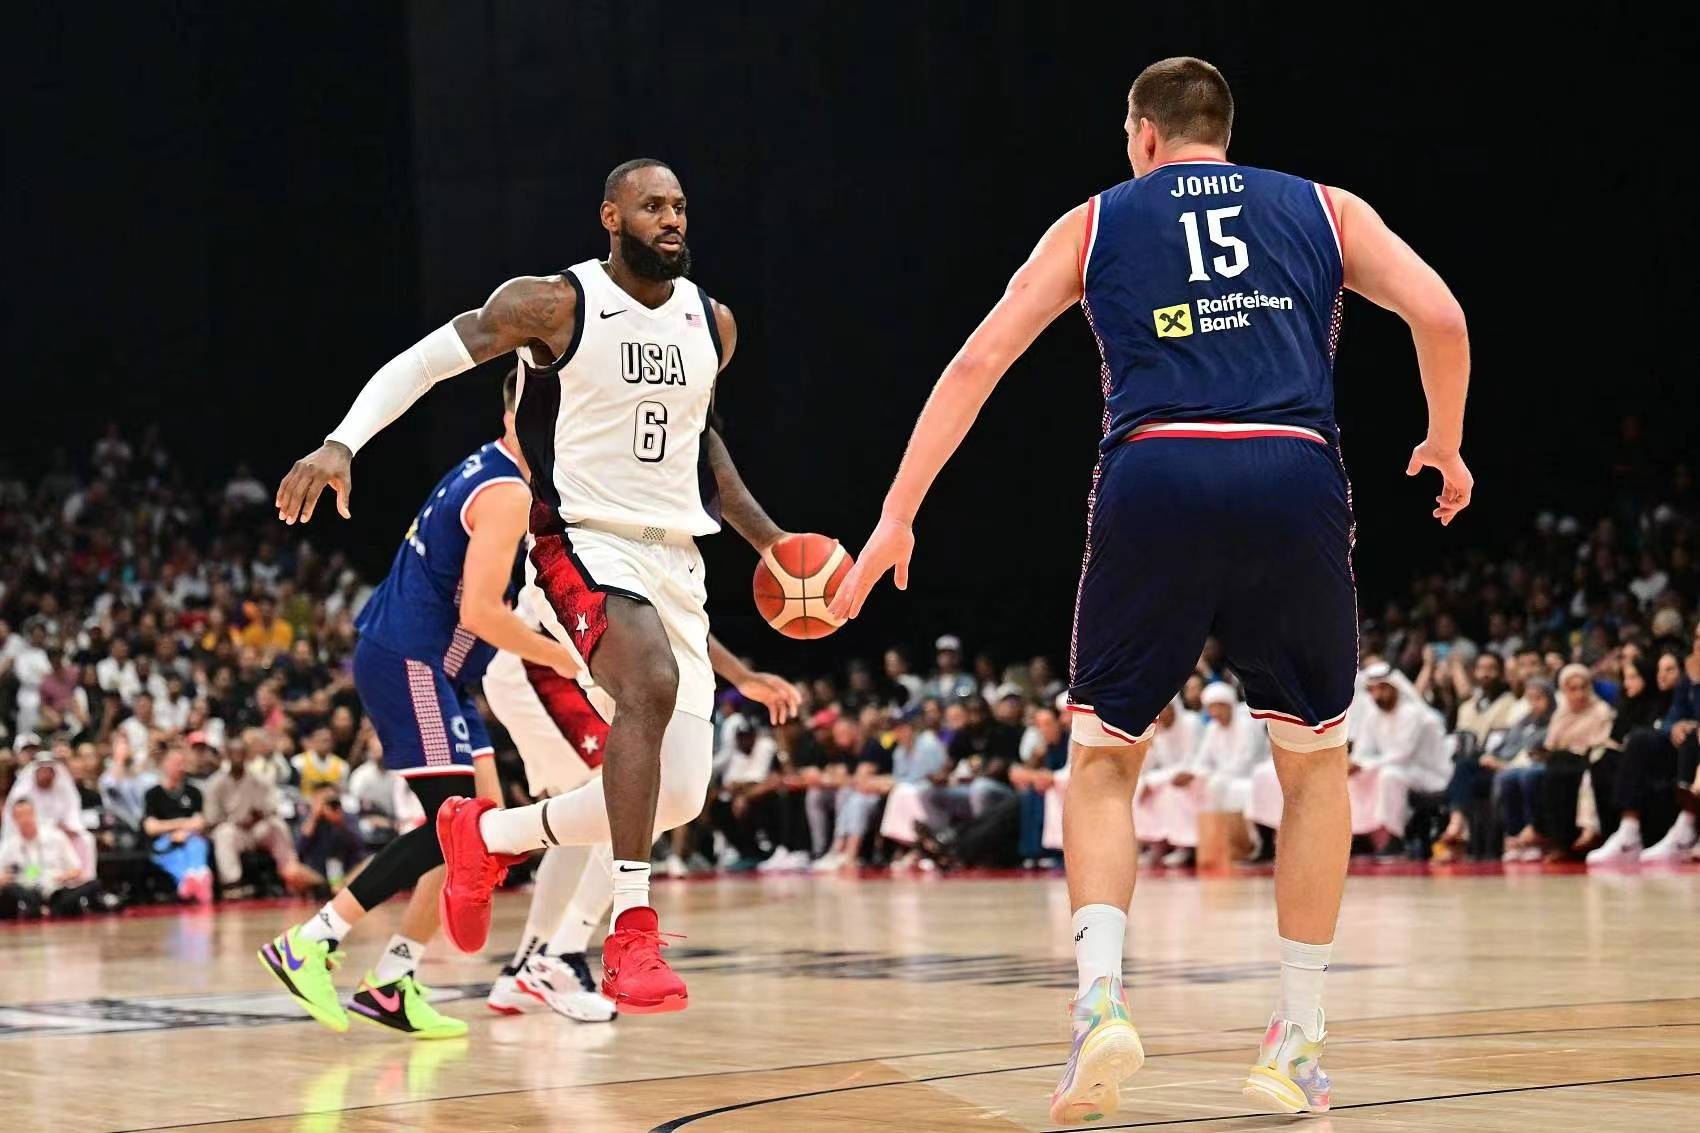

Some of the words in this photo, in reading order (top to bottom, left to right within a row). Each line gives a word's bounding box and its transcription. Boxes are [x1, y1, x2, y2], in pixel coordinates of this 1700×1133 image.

[1178, 204, 1250, 283] 15
[1196, 290, 1293, 315] Raiffeisen
[1199, 311, 1251, 333] Bank
[621, 342, 686, 386] USA
[633, 400, 667, 463] 6
